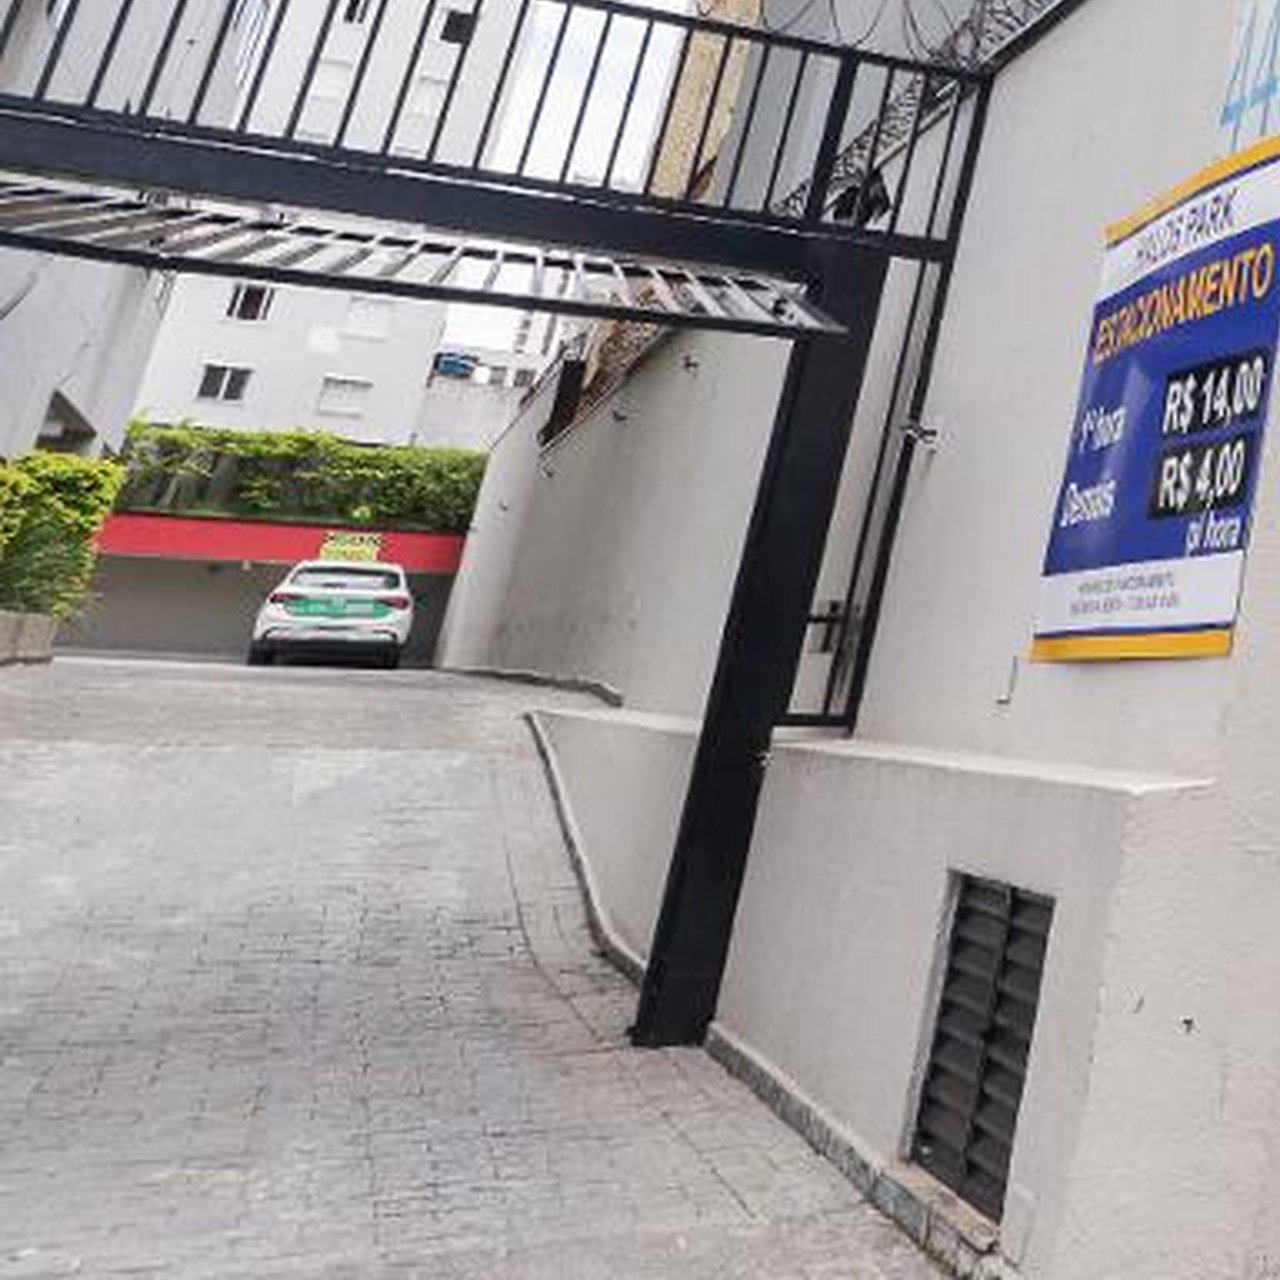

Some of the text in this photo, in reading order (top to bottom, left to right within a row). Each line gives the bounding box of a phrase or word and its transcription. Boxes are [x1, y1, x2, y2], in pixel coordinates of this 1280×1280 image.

[1162, 357, 1266, 434] R$ 14,00
[1158, 439, 1245, 510] R$ 4,00
[1202, 511, 1241, 549] hora
